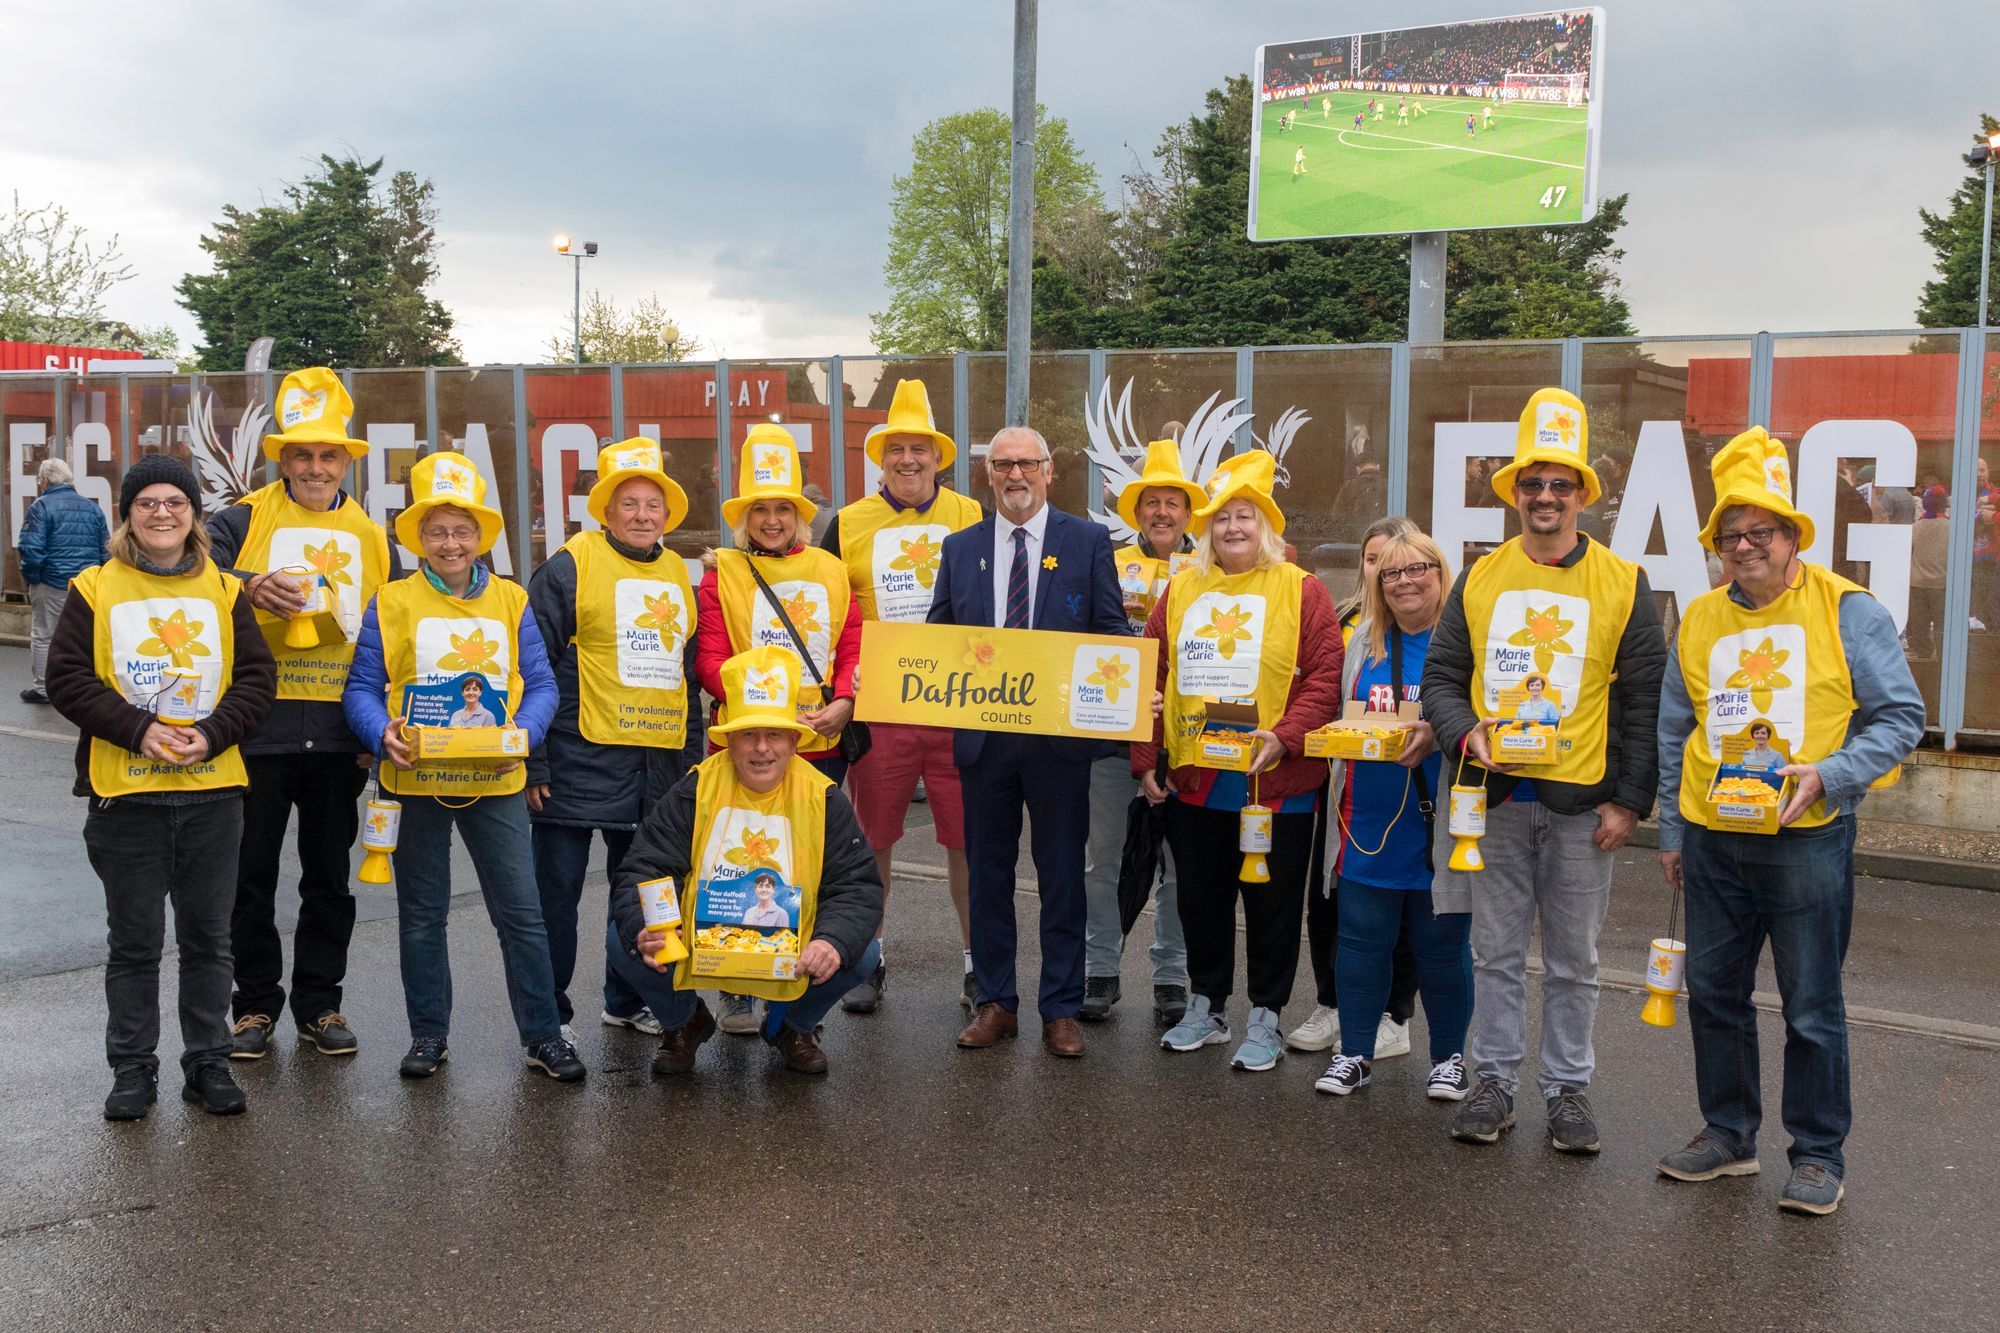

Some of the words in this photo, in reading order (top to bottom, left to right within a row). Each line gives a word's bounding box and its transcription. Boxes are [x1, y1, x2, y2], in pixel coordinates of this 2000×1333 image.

[1539, 186, 1568, 208] 47
[882, 572, 913, 583] Marie
[886, 582, 914, 592] Curie
[627, 631, 658, 640] Marie
[761, 630, 791, 640] Marie
[631, 640, 660, 651] Curie
[1184, 640, 1215, 650] Marie
[1187, 650, 1214, 660] Curie
[1496, 648, 1530, 660] Marie
[286, 658, 352, 670] volunteerin
[898, 657, 938, 673] every
[1498, 661, 1528, 672] Curie
[134, 673, 162, 685] Curi
[284, 674, 318, 683] Marie
[320, 676, 345, 685] Curi
[901, 671, 1036, 708] Daffodil
[1078, 685, 1103, 695] Marie
[1080, 694, 1103, 703] Curie
[1716, 692, 1748, 704] Marie
[619, 704, 635, 713] I'm
[1717, 704, 1747, 717] Curie
[980, 710, 1032, 725] counts
[619, 718, 635, 728] for
[637, 720, 663, 730] Marie
[128, 766, 148, 776] for
[150, 764, 182, 775] Marie
[186, 763, 216, 775] Curie
[416, 771, 433, 781] for
[436, 772, 469, 782] Marie
